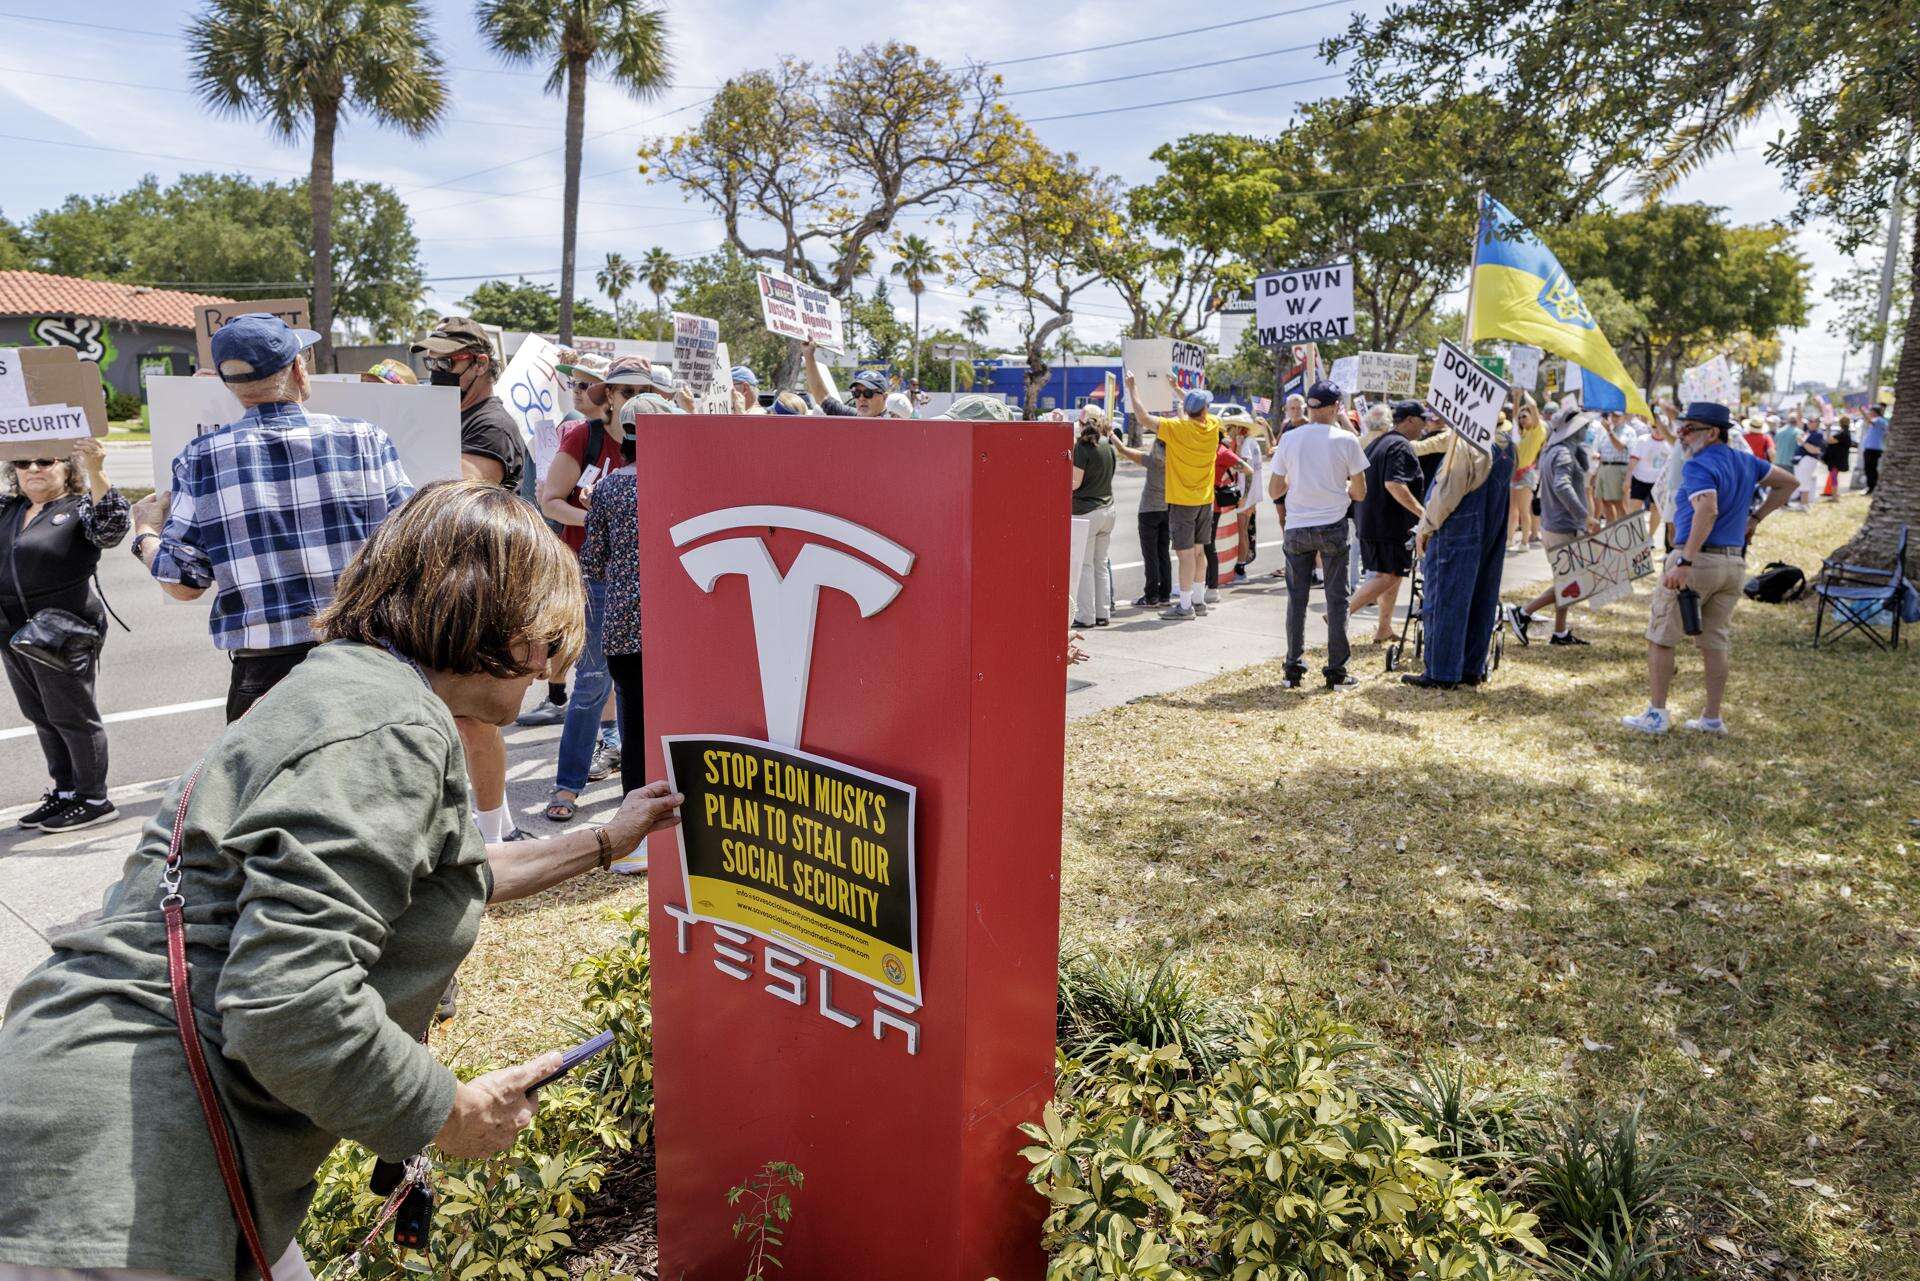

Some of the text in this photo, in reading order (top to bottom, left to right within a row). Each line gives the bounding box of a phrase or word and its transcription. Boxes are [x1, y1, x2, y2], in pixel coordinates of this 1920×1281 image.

[1265, 269, 1341, 297] DOWN
[767, 299, 796, 321] Justice
[802, 312, 832, 330] Dignity
[1286, 296, 1322, 316] W/
[1443, 350, 1495, 404] DOWN
[1454, 383, 1480, 411] W/
[0, 413, 81, 435] SECURITY
[1434, 388, 1491, 443] TRUMP
[703, 749, 887, 835] STOP ELON MUSK'S
[704, 793, 890, 886] PLAN TO STEAL OUR
[721, 838, 880, 928] SOCIAL SECURITY
[663, 903, 921, 1056] TESLA
